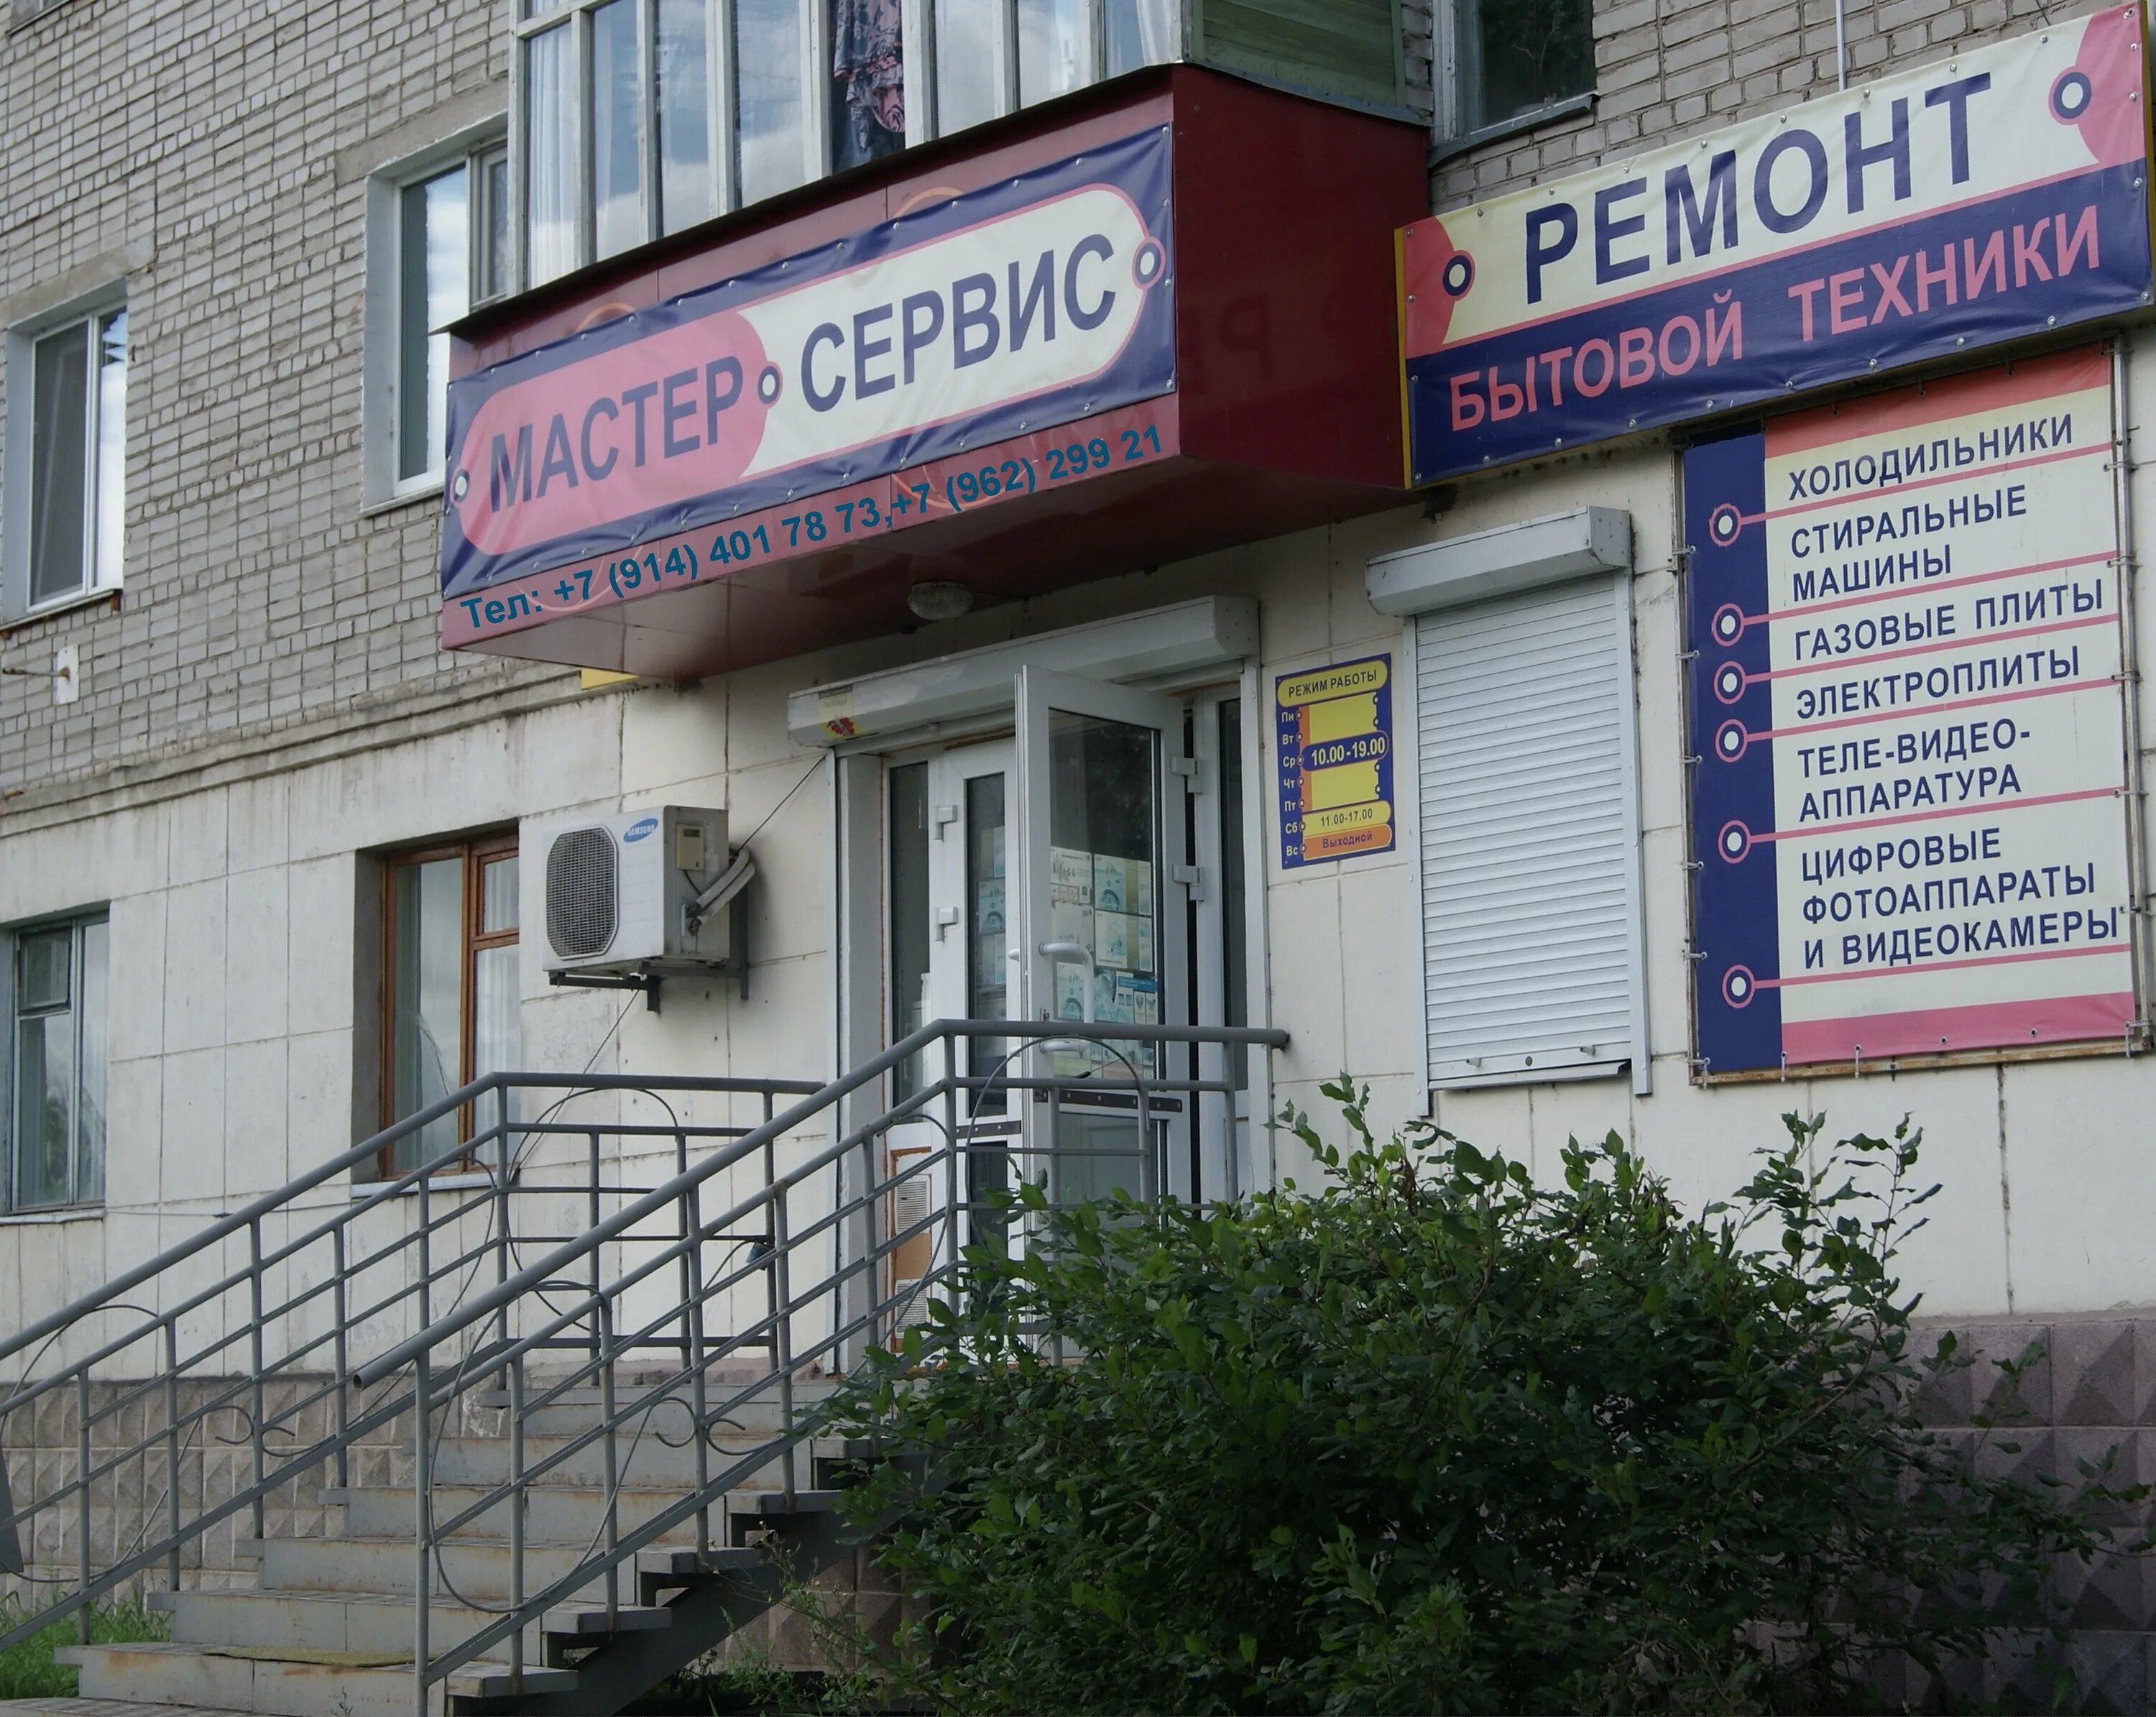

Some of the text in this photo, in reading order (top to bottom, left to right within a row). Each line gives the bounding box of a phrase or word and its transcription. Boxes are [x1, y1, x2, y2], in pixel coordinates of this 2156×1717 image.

[1525, 72, 1992, 305] РЕМОНТ
[1450, 206, 2100, 431] БЫТОВОЙ ТЕХНИКИ
[489, 234, 1115, 512] МАСТЕР СЕРВИС
[1788, 413, 2073, 500] ХОЛОДИЛЬНИКИ
[460, 589, 543, 629] Тел:
[554, 570, 595, 602] +7
[609, 544, 699, 598] (914)
[709, 525, 771, 565] 401
[781, 511, 827, 548] 78
[946, 458, 1036, 512] (962)
[1045, 438, 1110, 480] 299
[1120, 424, 1163, 461] 21
[1790, 484, 2027, 558] СТИРАЛЬНЫЕ
[1793, 544, 1951, 602] МАШИНЫ
[1795, 579, 2102, 660] ГАЗОВЫЕ ПЛИТЫ
[1289, 669, 1377, 697] РЕЖИМ РАБОТЫ
[1796, 645, 2079, 719] ЭЛЕКТРОПЛИТЫ
[1281, 711, 1294, 722] Пн
[1282, 732, 1294, 745] Вт
[1283, 755, 1296, 770] Ср
[1311, 736, 1386, 765] 10.00-19.00
[1797, 717, 2031, 778] ТЕЛЕ-ВИДЕО-
[1284, 778, 1295, 789] Чт
[1284, 800, 1296, 811] Пт
[1799, 763, 2022, 822] АППАРАТУРА
[1285, 821, 1298, 834] Сб
[1321, 808, 1373, 827] 11.00-17.00
[1322, 831, 1373, 849] Выходной
[1286, 844, 1299, 856] Вс
[1802, 827, 2001, 885] ЦИФРОВЫЕ
[1802, 862, 2095, 924] ФОТОАППАРАТЫ
[1805, 907, 2117, 969] И ВИДЕОКАМЕРЫ
